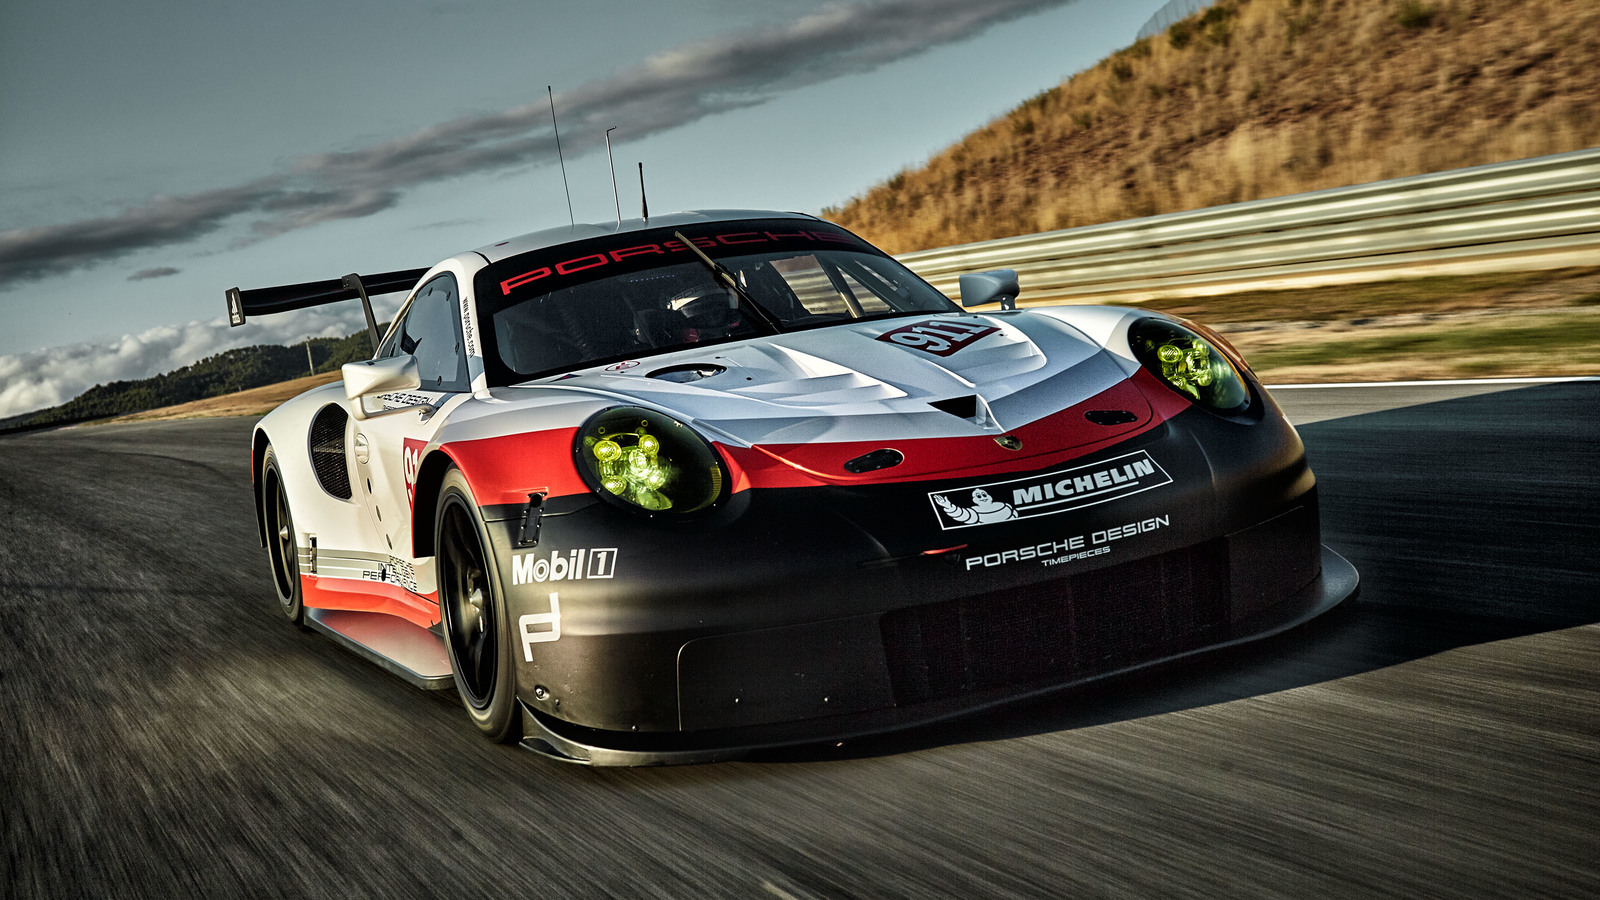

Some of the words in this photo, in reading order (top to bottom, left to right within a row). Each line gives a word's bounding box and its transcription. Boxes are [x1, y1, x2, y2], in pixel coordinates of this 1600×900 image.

[500, 230, 856, 295] PORSCHE
[462, 296, 475, 358] www.porsche.com
[889, 321, 990, 352] 911
[1012, 458, 1155, 505] MICHELIN
[965, 535, 1085, 571] PORSCHE
[1091, 514, 1170, 545] DESIGN
[1041, 545, 1111, 567] TIMEPIECES
[512, 549, 586, 585] Mobil
